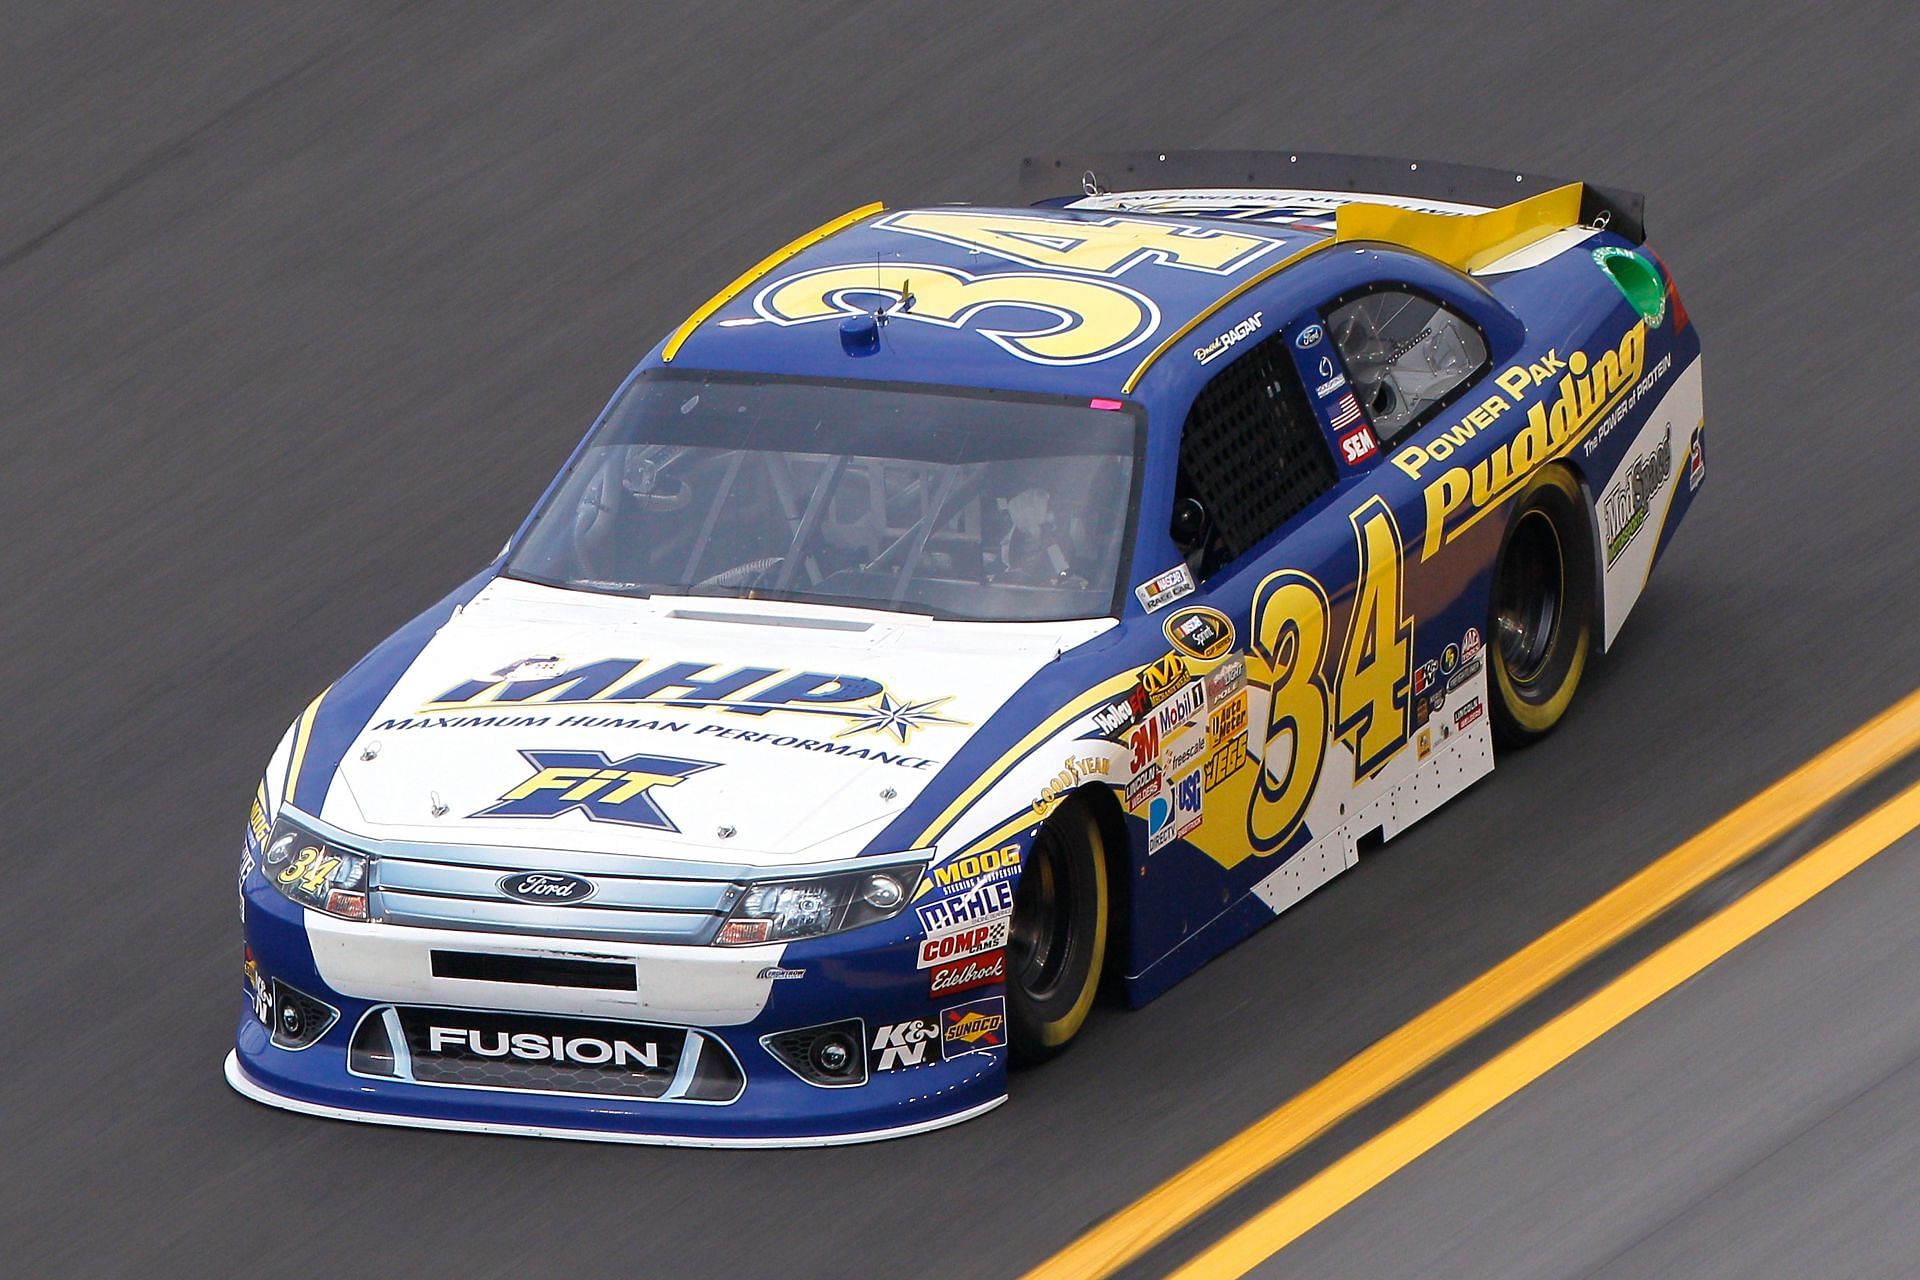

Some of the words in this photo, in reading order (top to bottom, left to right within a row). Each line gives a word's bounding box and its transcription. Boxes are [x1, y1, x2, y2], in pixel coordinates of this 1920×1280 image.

[752, 209, 1289, 366] 34
[1220, 312, 1264, 350] RAGAN
[1303, 328, 1320, 346] Ford
[1391, 395, 1511, 481] POWER
[1495, 349, 1567, 402] PAK
[1583, 438, 1599, 457] The
[1597, 403, 1628, 443] POWER
[1628, 390, 1637, 409] of
[1637, 352, 1672, 401] PROTEIN
[1343, 429, 1375, 462] SEM
[1421, 319, 1646, 564] Pudding
[1147, 592, 1173, 609] RACE
[1173, 583, 1193, 596] CAR
[1157, 571, 1183, 591] NASCAR
[1192, 625, 1215, 646] Sprint
[430, 658, 884, 716] MHP
[1213, 684, 1239, 705] POLE
[1246, 494, 1415, 859] 34
[1094, 700, 1136, 736] Holley
[1160, 691, 1191, 733] Mobil
[1218, 709, 1246, 738] Meter
[1221, 699, 1242, 725] Auto
[373, 715, 552, 731] MAXIMUM
[556, 715, 691, 733] HUMAN
[694, 723, 940, 772] PERFORMANCE
[1130, 717, 1160, 774] 3M
[1171, 736, 1206, 771] freescale
[1203, 730, 1249, 794] JEGS
[1126, 765, 1157, 799] LINCOLN
[1130, 780, 1160, 809] WELDERS
[1178, 769, 1202, 813] USG
[1149, 823, 1176, 852] DIRECTV
[278, 846, 344, 896] 34
[934, 843, 1022, 888] MOOG
[517, 873, 577, 898] Ford
[943, 878, 975, 896] STEERING
[918, 882, 1012, 931] MAHLE
[923, 926, 990, 962] COMP
[969, 938, 1000, 954] CAMS
[931, 957, 1003, 991] Edelbrock
[945, 1014, 1003, 1042] SUNOCO
[429, 1025, 659, 1069] FUSION
